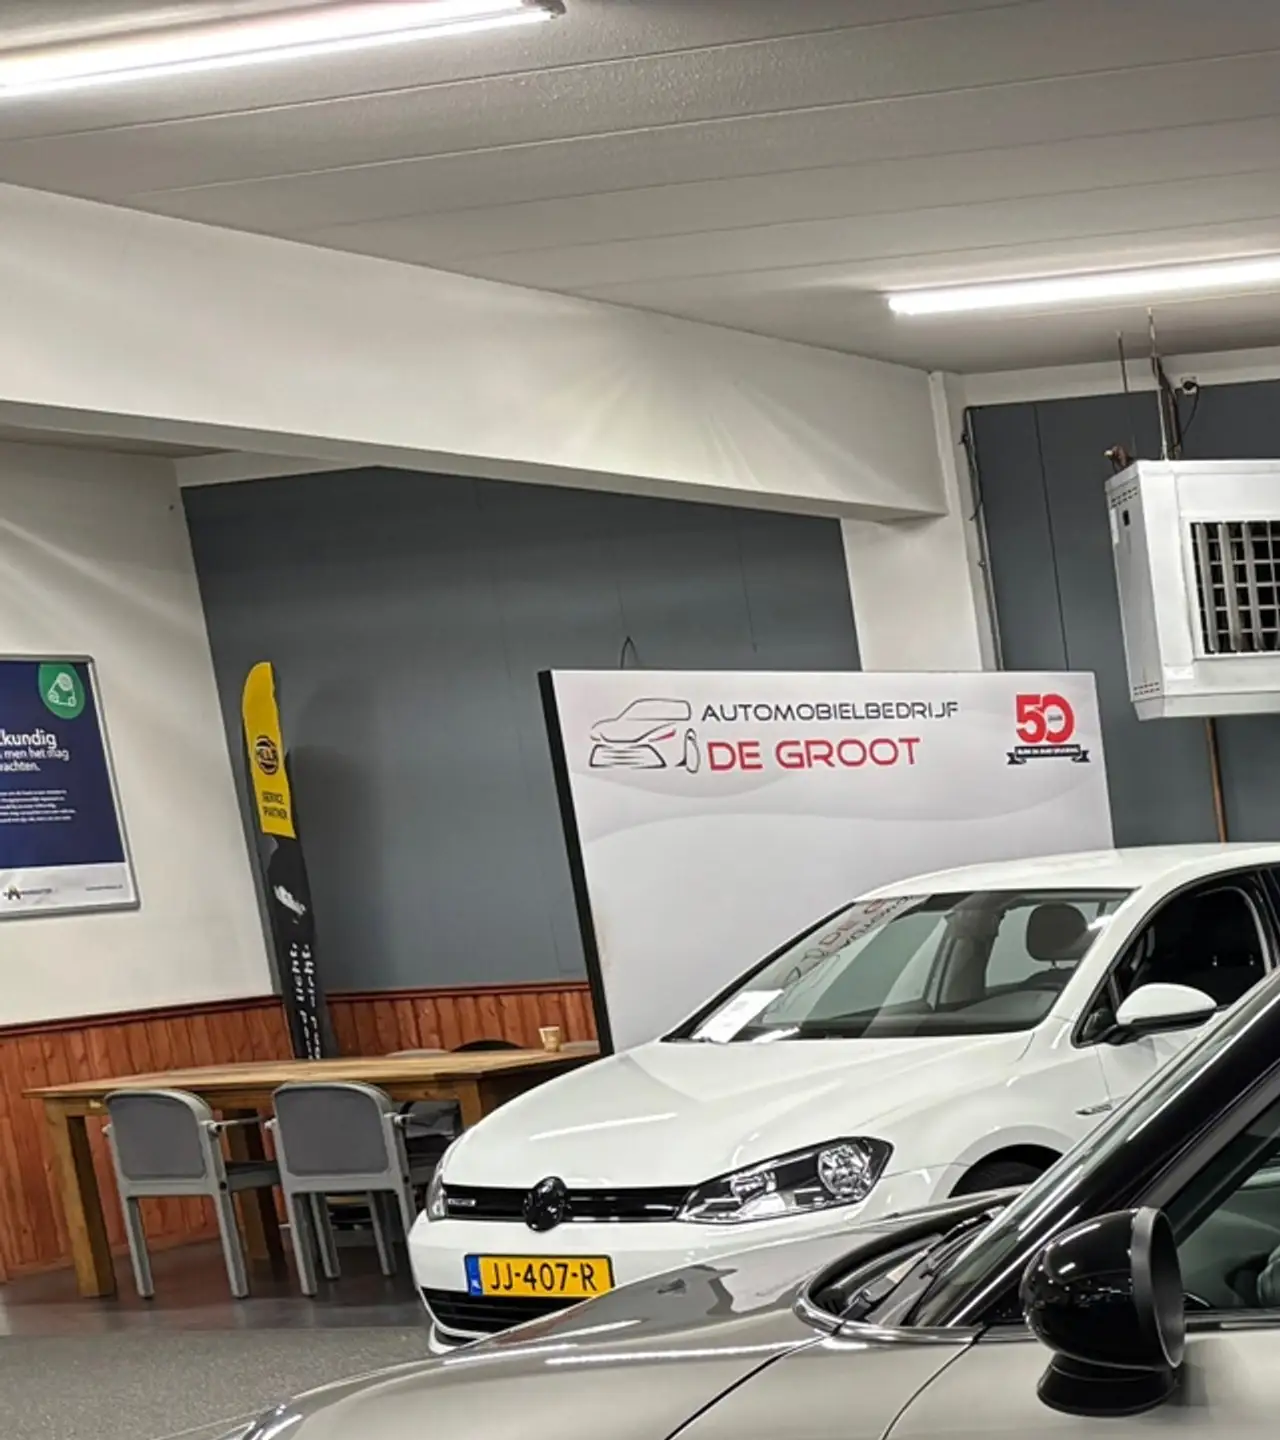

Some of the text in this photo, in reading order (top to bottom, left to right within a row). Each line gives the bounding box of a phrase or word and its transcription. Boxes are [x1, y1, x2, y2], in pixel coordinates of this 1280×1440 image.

[701, 701, 958, 721] AUTOMOBIELBEDRIJF
[1016, 694, 1074, 744] 50
[0, 728, 57, 749] kundig
[707, 737, 920, 771] DE GROOT
[491, 1262, 597, 1292] JJ-407-R
